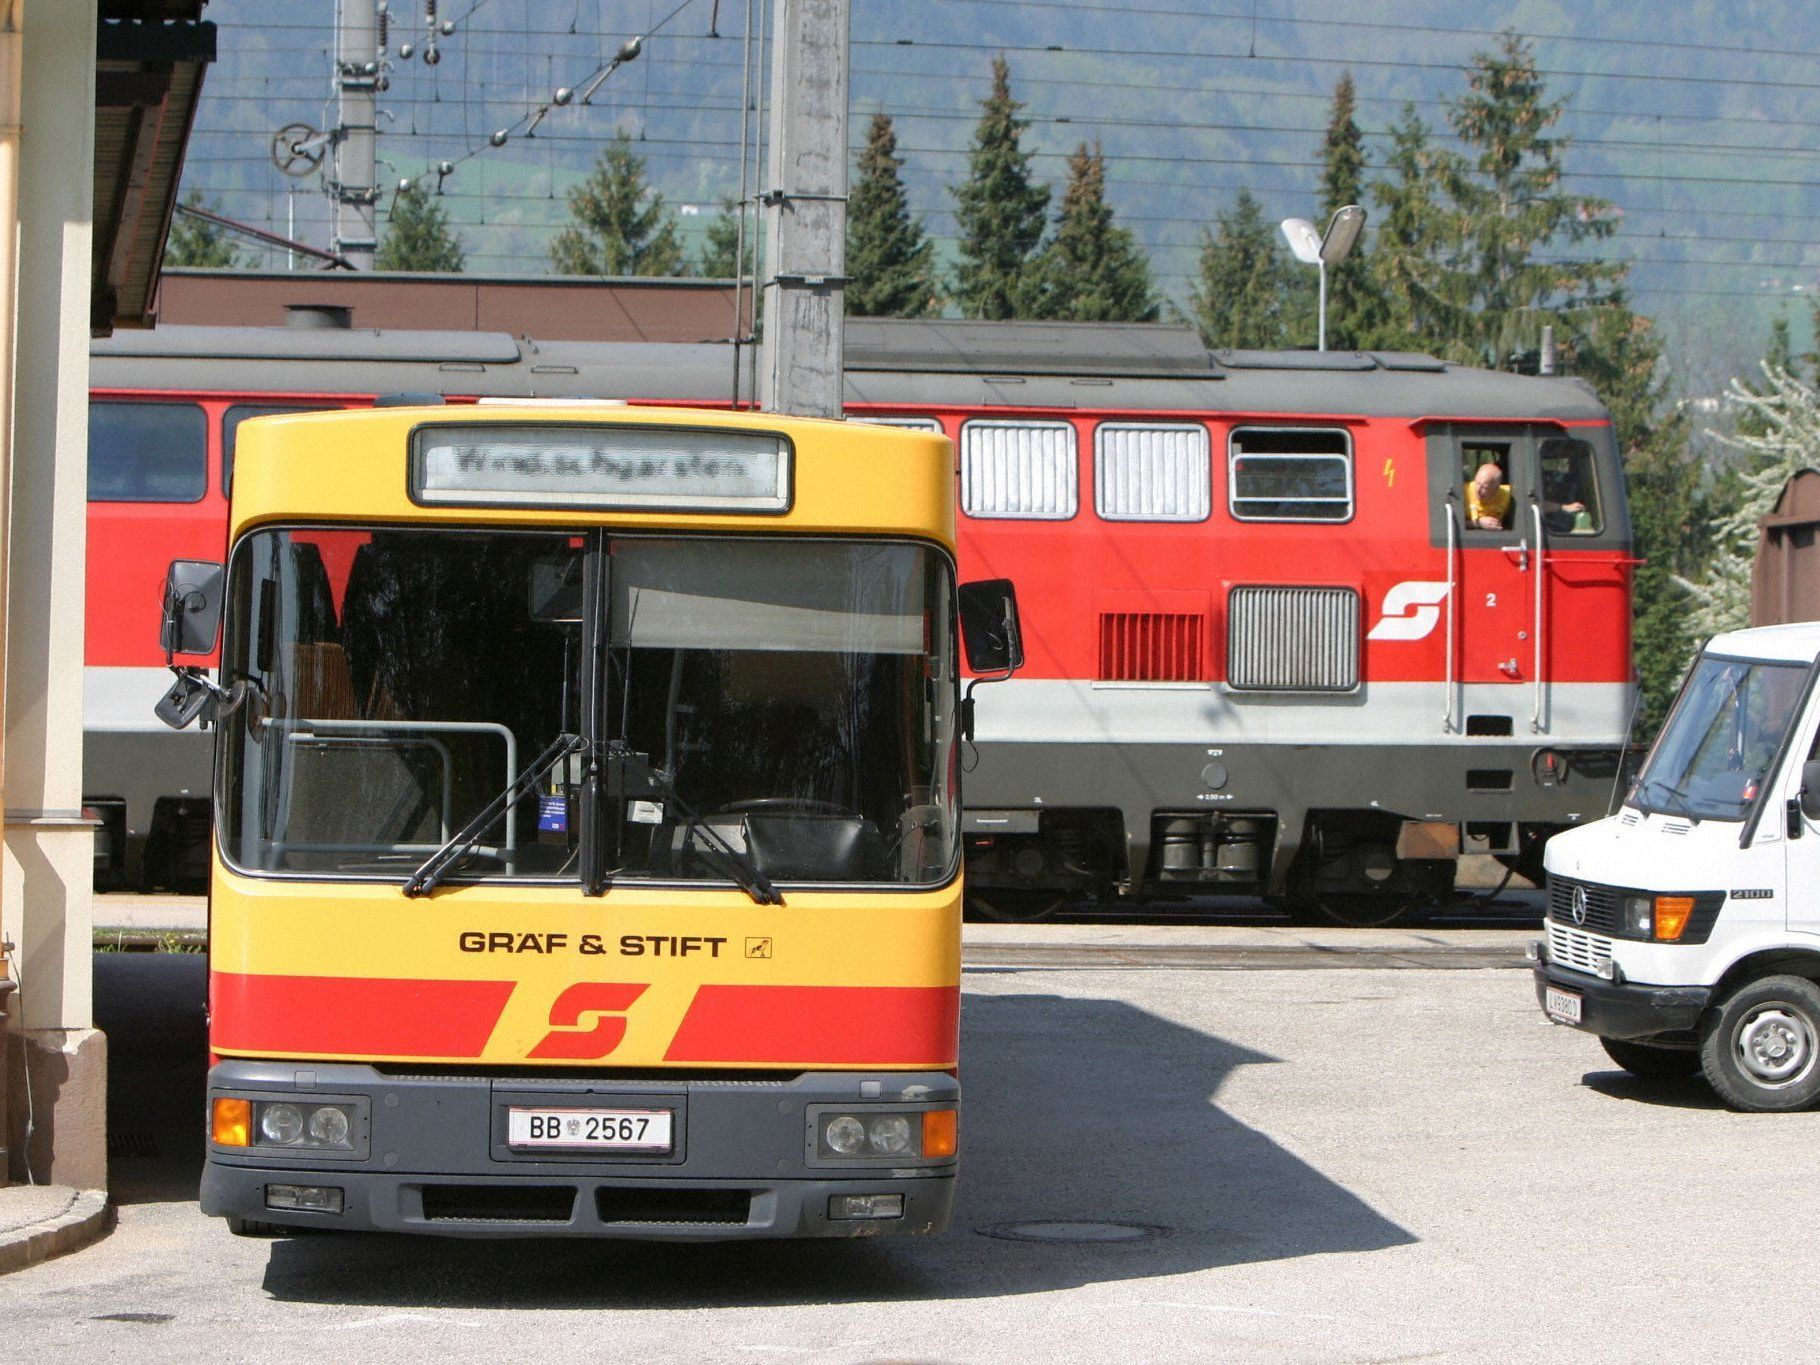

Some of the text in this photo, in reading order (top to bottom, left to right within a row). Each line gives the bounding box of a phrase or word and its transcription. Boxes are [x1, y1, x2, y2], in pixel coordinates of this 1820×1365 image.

[1486, 593, 1496, 607] 2
[459, 931, 728, 958] GRÄF & STIFT
[530, 1116, 651, 1141] BB 2567
